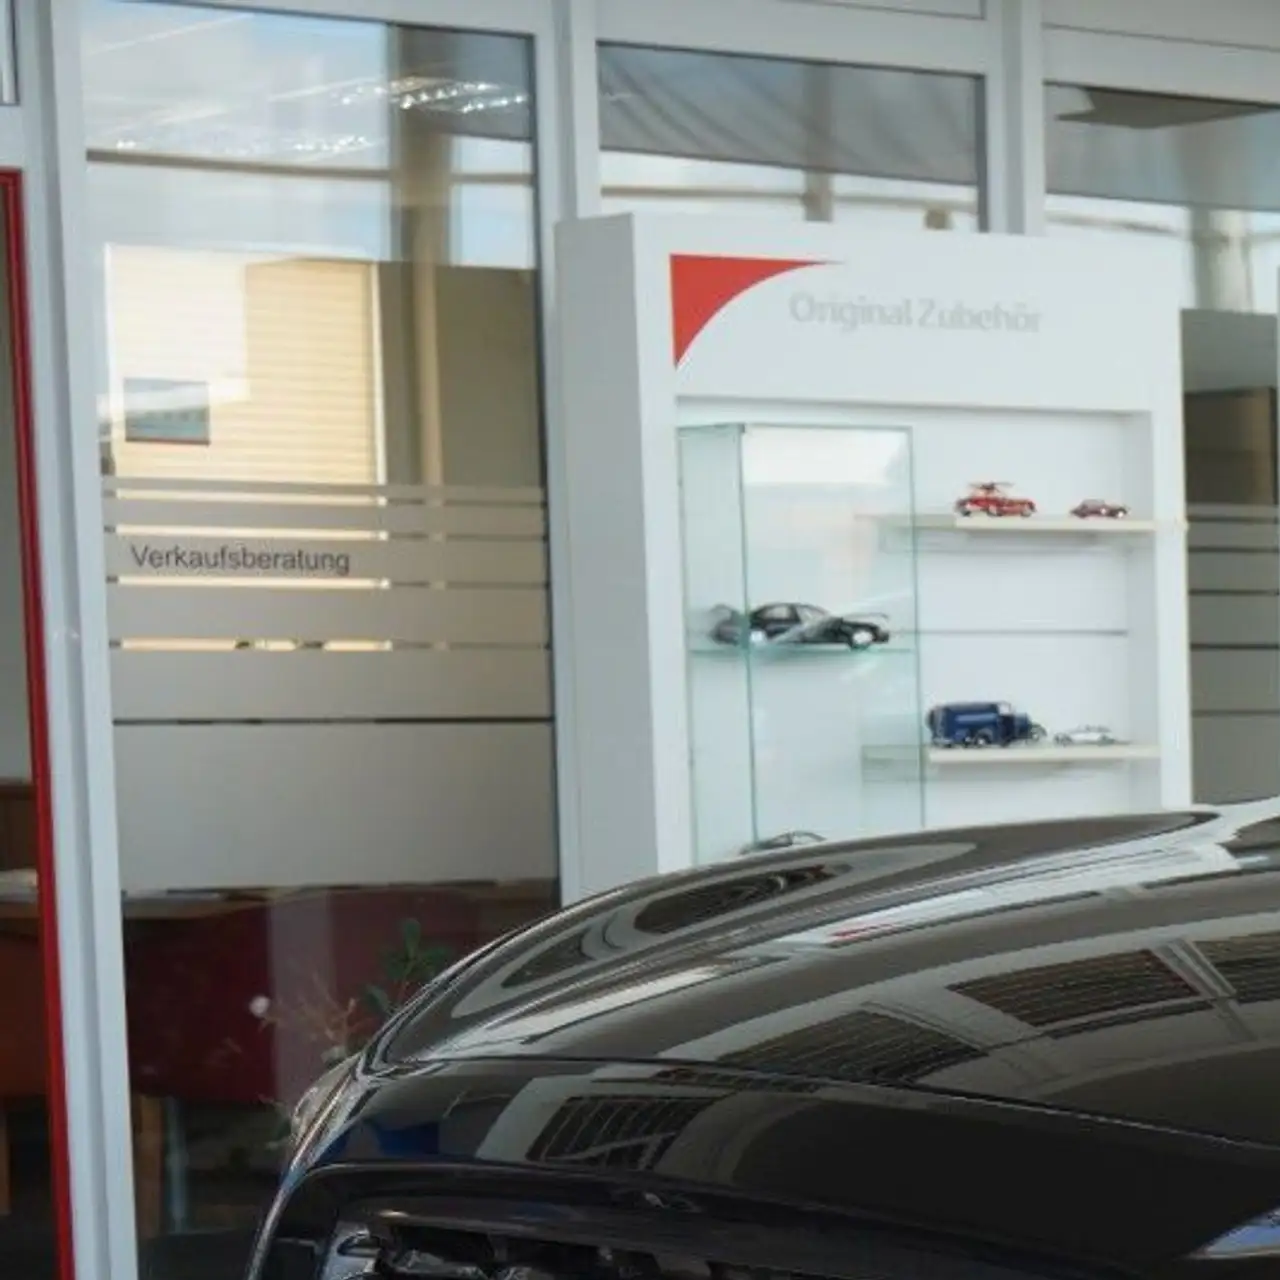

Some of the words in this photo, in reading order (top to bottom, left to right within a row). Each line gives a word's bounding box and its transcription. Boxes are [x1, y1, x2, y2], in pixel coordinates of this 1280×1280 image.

[789, 291, 913, 334] Original
[917, 297, 1040, 333] Zubehör
[130, 543, 350, 575] Verkaufsberatung
